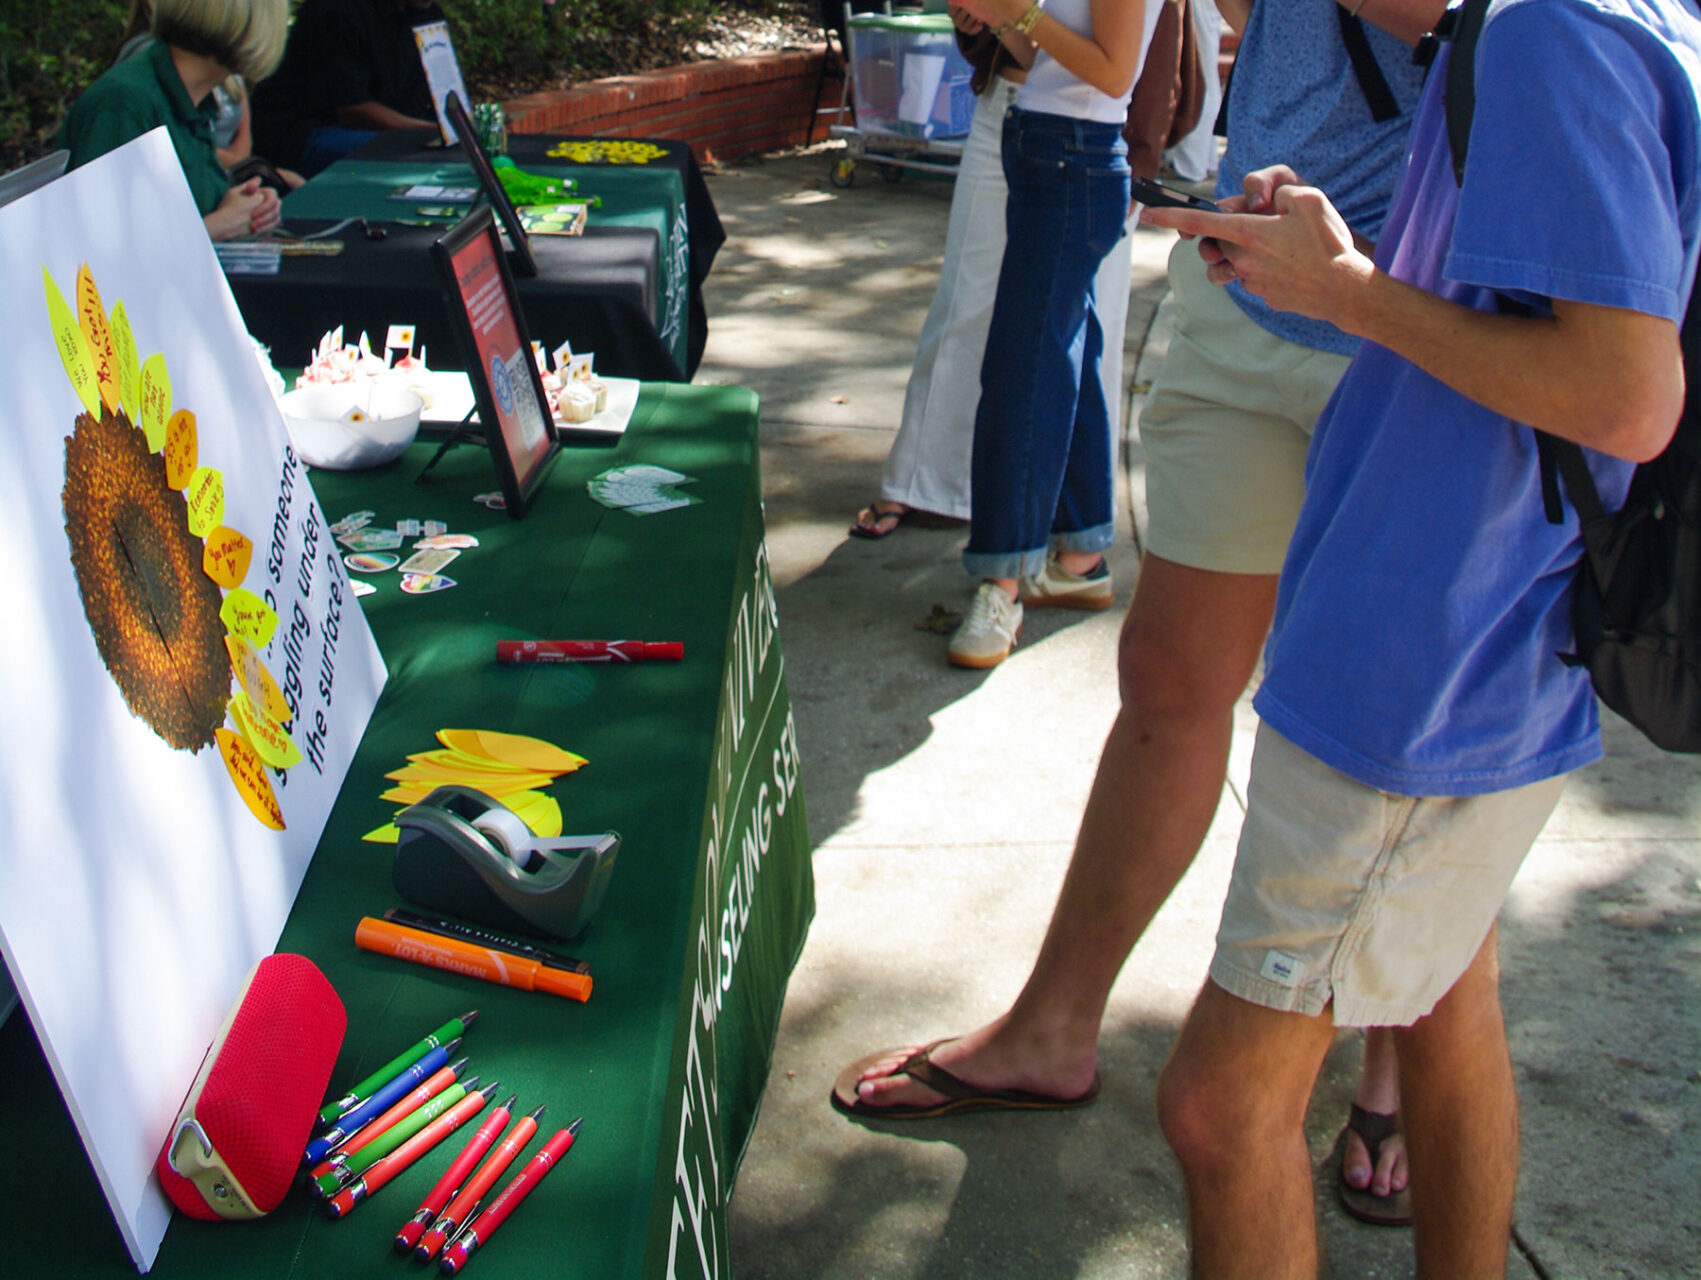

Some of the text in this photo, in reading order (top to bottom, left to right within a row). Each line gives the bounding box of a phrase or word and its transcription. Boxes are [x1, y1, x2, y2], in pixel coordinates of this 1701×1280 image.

[268, 444, 298, 584] someone
[273, 501, 322, 788] suggling under
[305, 554, 346, 776] the surface?
